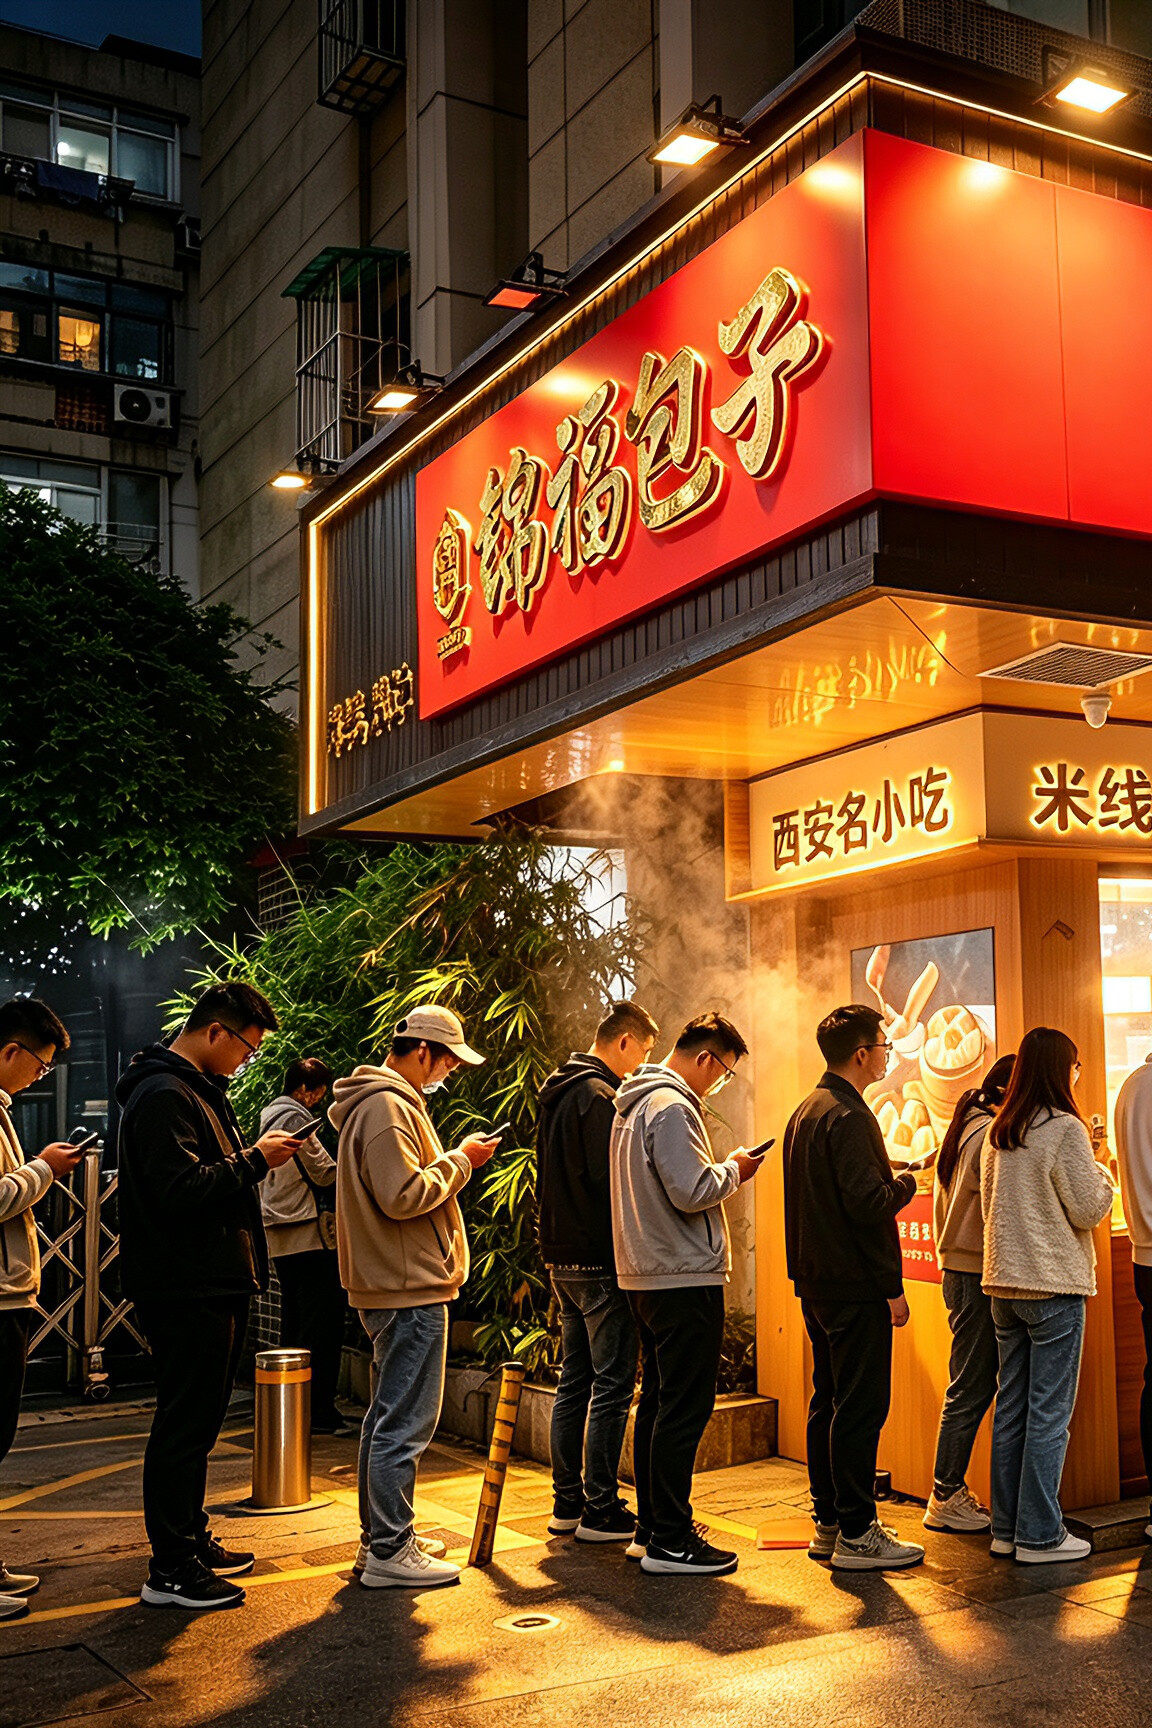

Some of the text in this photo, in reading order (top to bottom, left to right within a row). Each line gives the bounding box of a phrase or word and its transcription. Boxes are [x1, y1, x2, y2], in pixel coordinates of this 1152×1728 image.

[474, 267, 823, 615] 锦福包子
[772, 767, 949, 871] 西安名小吃
[1034, 763, 1152, 833] 米线
